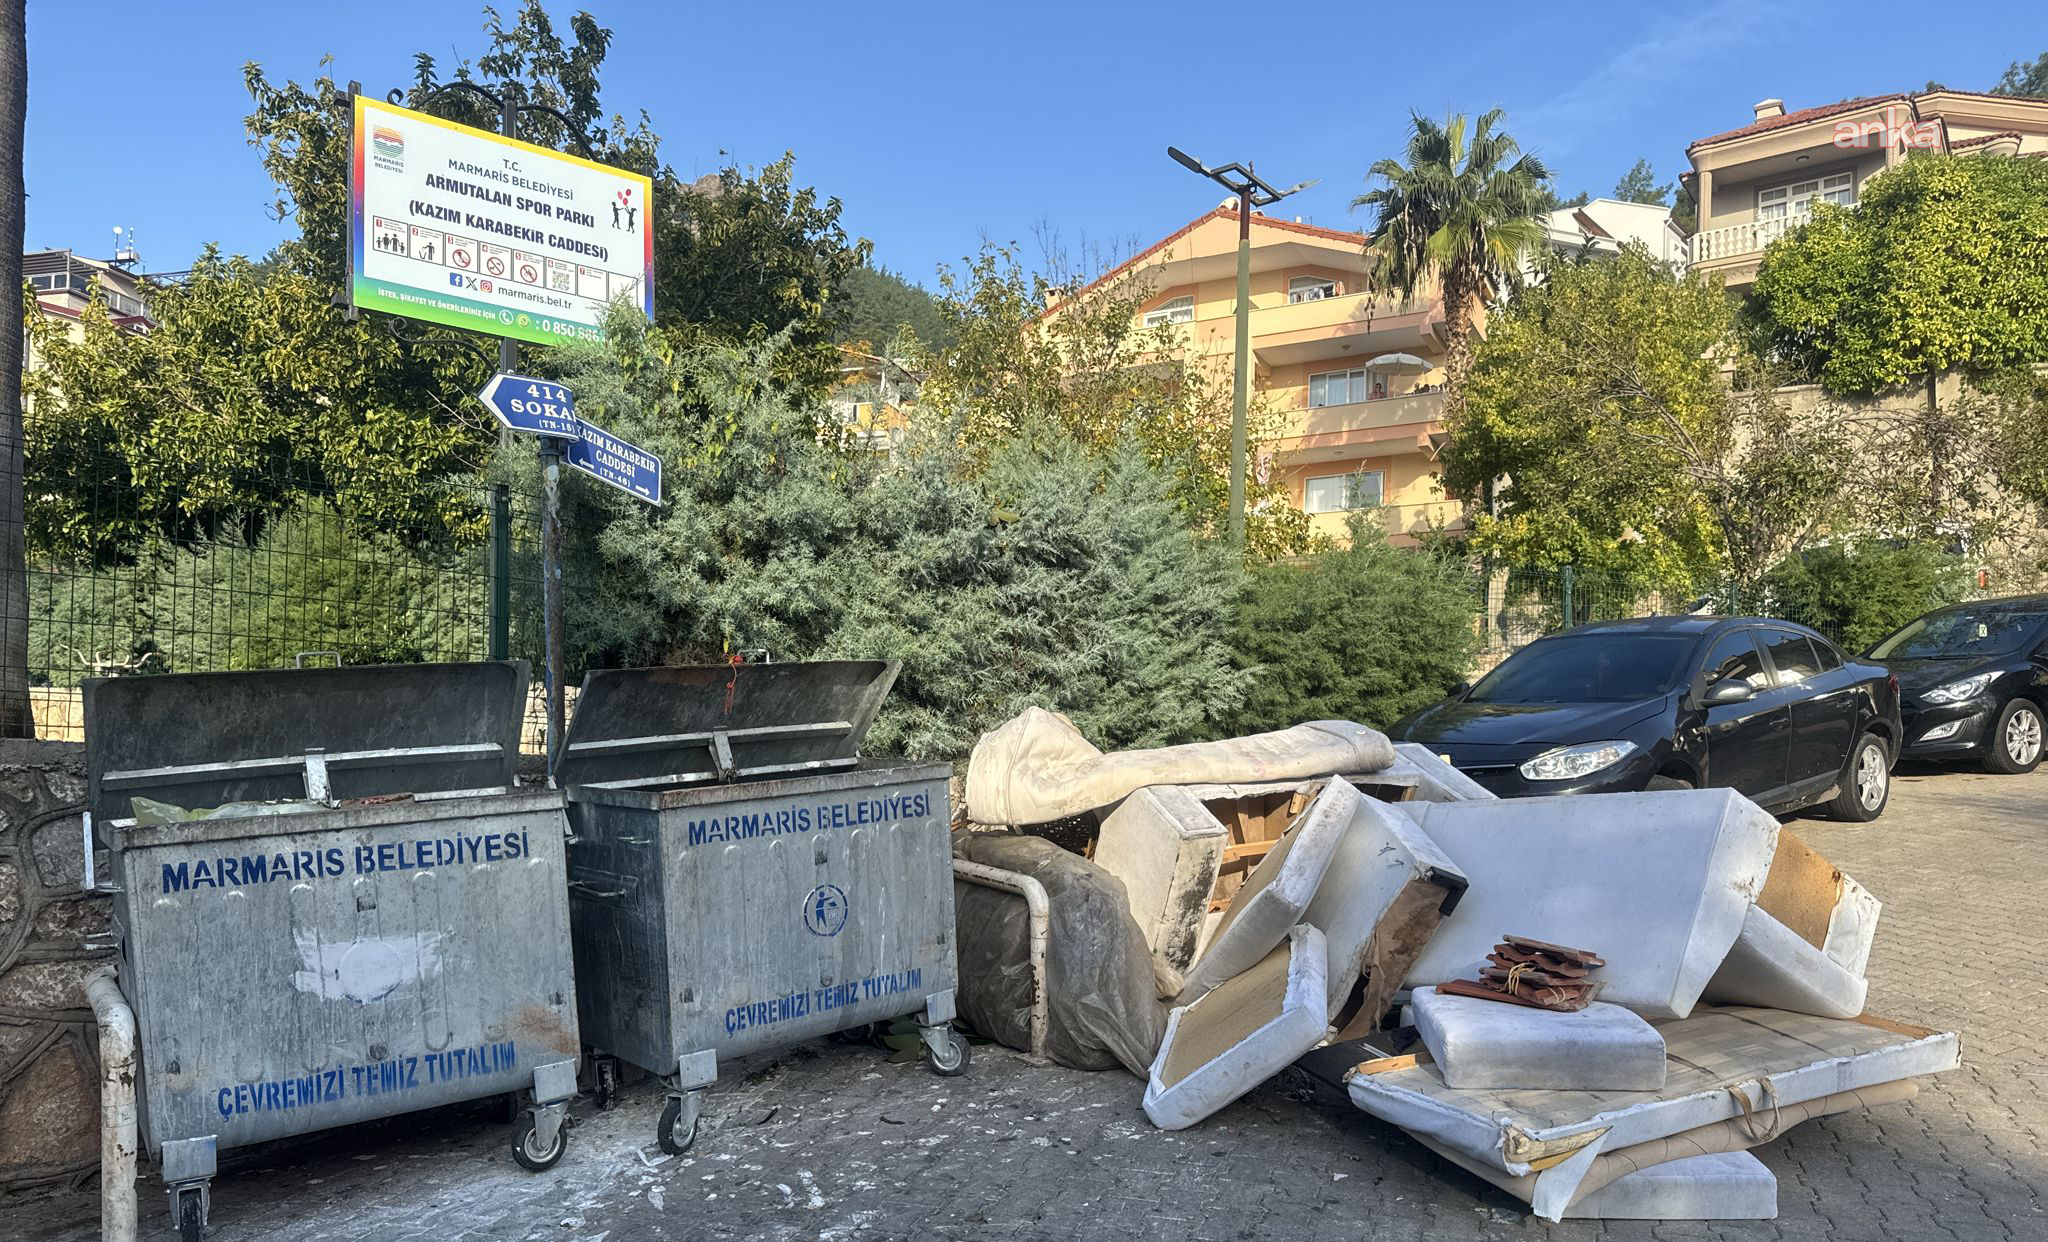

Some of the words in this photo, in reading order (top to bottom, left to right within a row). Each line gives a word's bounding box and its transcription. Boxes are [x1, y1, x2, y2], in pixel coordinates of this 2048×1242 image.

[448, 158, 509, 184] MARMARİS
[512, 176, 574, 201] BELEDİYESİ
[503, 158, 522, 173] T.C.
[425, 173, 512, 207] ARMUTALAN
[516, 196, 552, 217] SPOR
[556, 206, 594, 228] PARKI
[409, 200, 461, 225] (KAZIM
[465, 213, 544, 244] KARABEKİR
[548, 234, 608, 262] CADDESİ)
[428, 298, 437, 308] VE
[498, 286, 573, 309] marmaris.bel.tr
[553, 321, 575, 337] 850
[527, 384, 567, 403] 414
[596, 450, 636, 478] CADDESİ
[605, 439, 656, 474] KARABEKİR
[688, 804, 811, 847] MARMARİS
[817, 789, 931, 830] BELEDİYESİ
[162, 847, 345, 894] MARMARİS
[355, 826, 529, 875] BELEDİYESİ
[725, 990, 810, 1039] ÇEVREMİZİ
[814, 978, 859, 1012] TEMİZ
[863, 967, 921, 1000] TUTALIM
[217, 1065, 344, 1123] ÇEVREMİZİ
[351, 1054, 419, 1098] TEMİZ
[424, 1040, 516, 1084] TUTALIM
